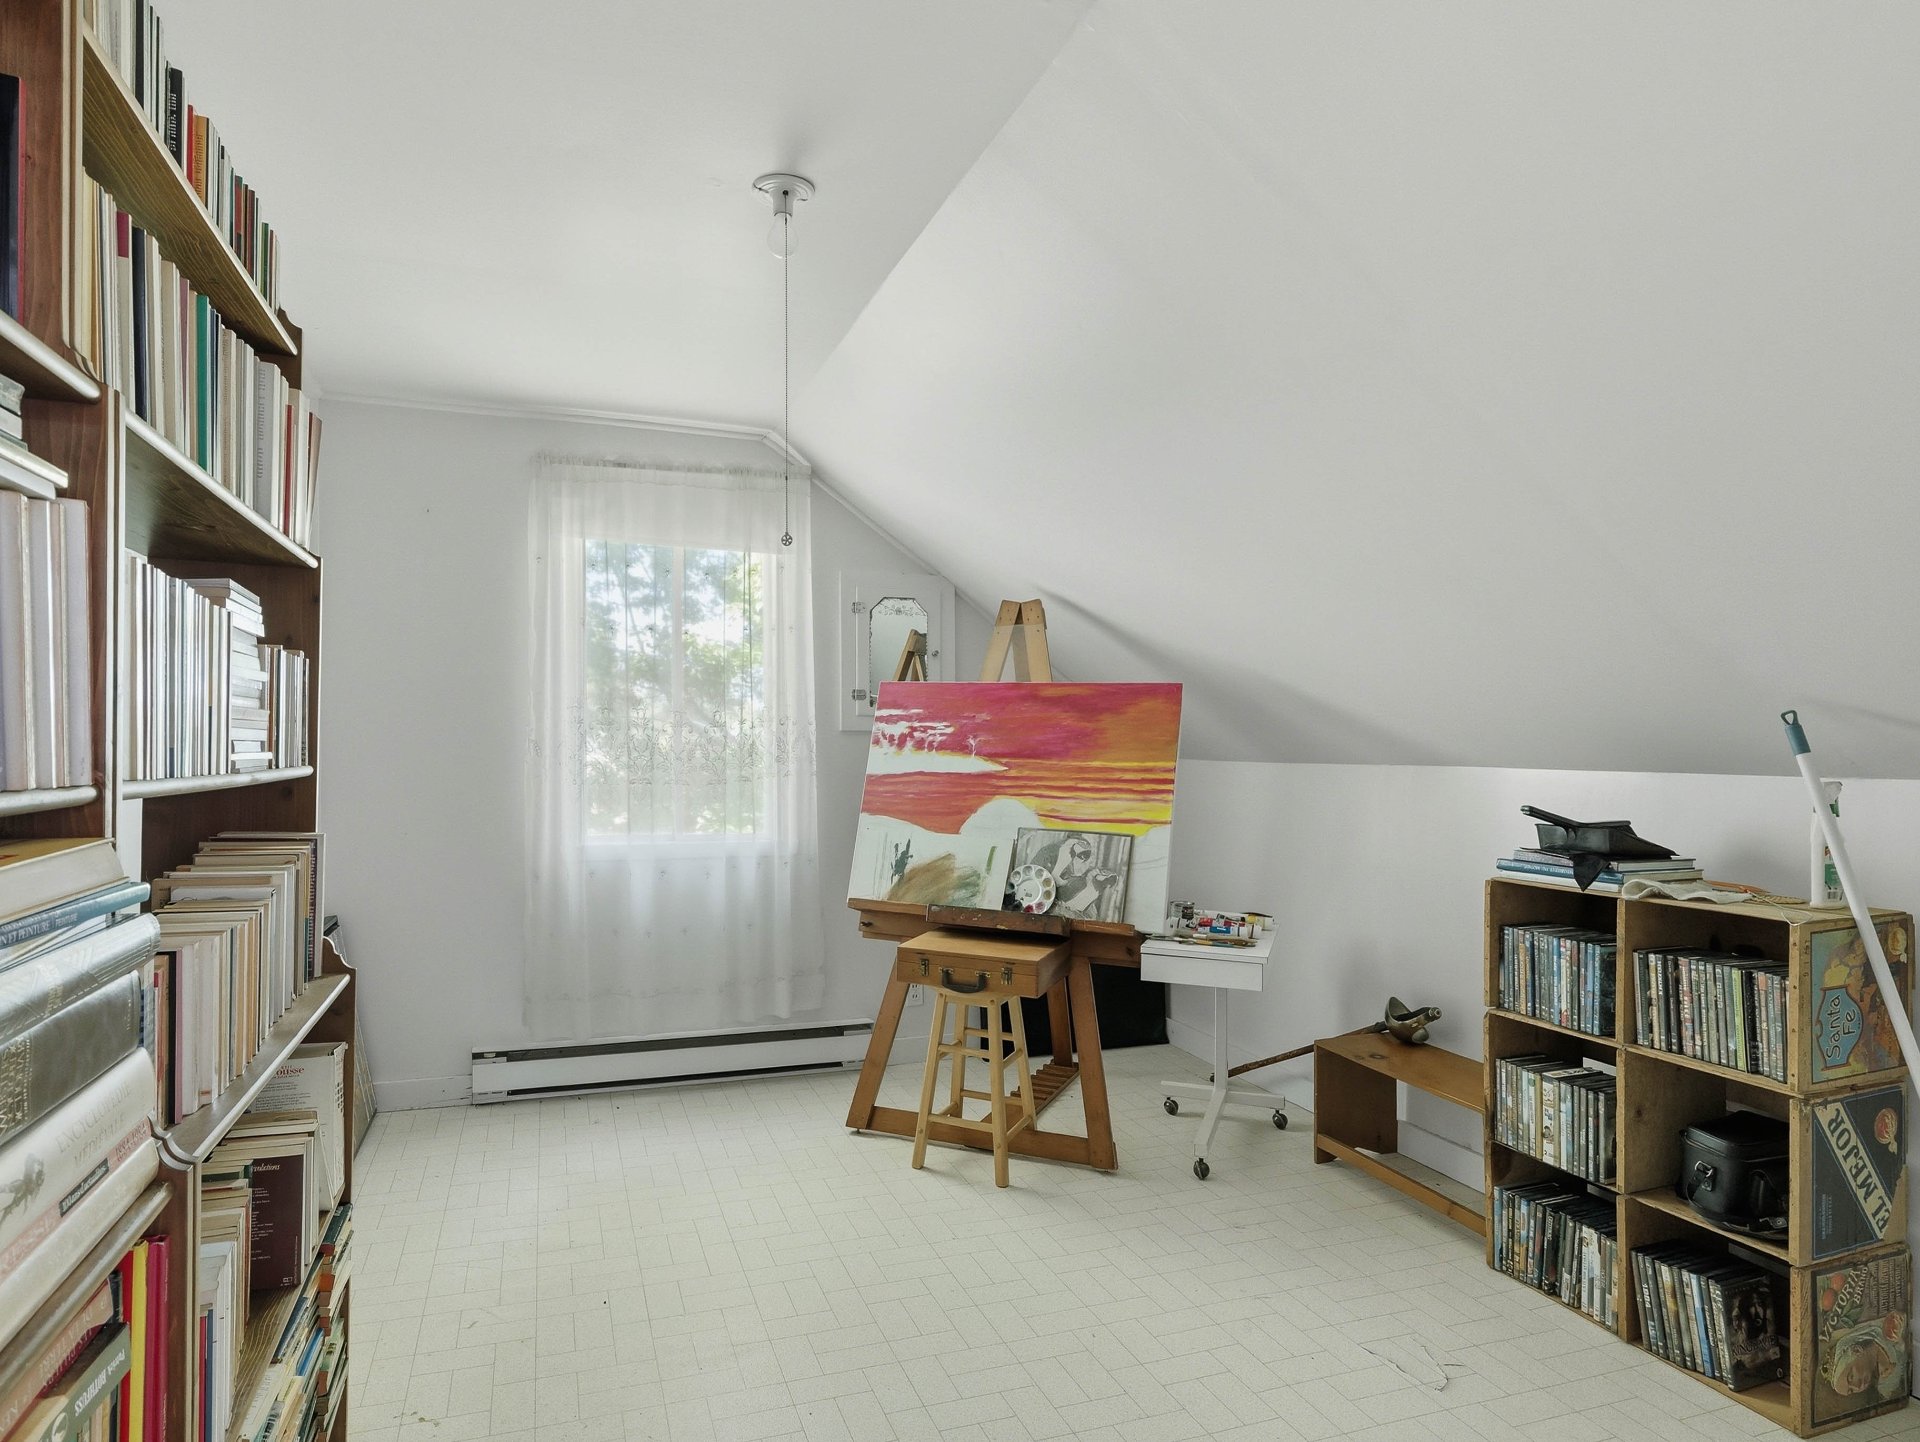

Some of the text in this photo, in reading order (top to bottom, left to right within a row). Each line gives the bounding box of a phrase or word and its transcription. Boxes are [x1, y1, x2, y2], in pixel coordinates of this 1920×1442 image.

[18, 920, 51, 941] PEINTURE
[1826, 994, 1841, 1060] Santa
[1842, 1008, 1856, 1039] Fe
[276, 1067, 304, 1077] ousse
[1827, 1107, 1891, 1234] EL MEJOR
[1853, 1266, 1868, 1304] BRAND
[1819, 1269, 1861, 1342] VICTORIA
